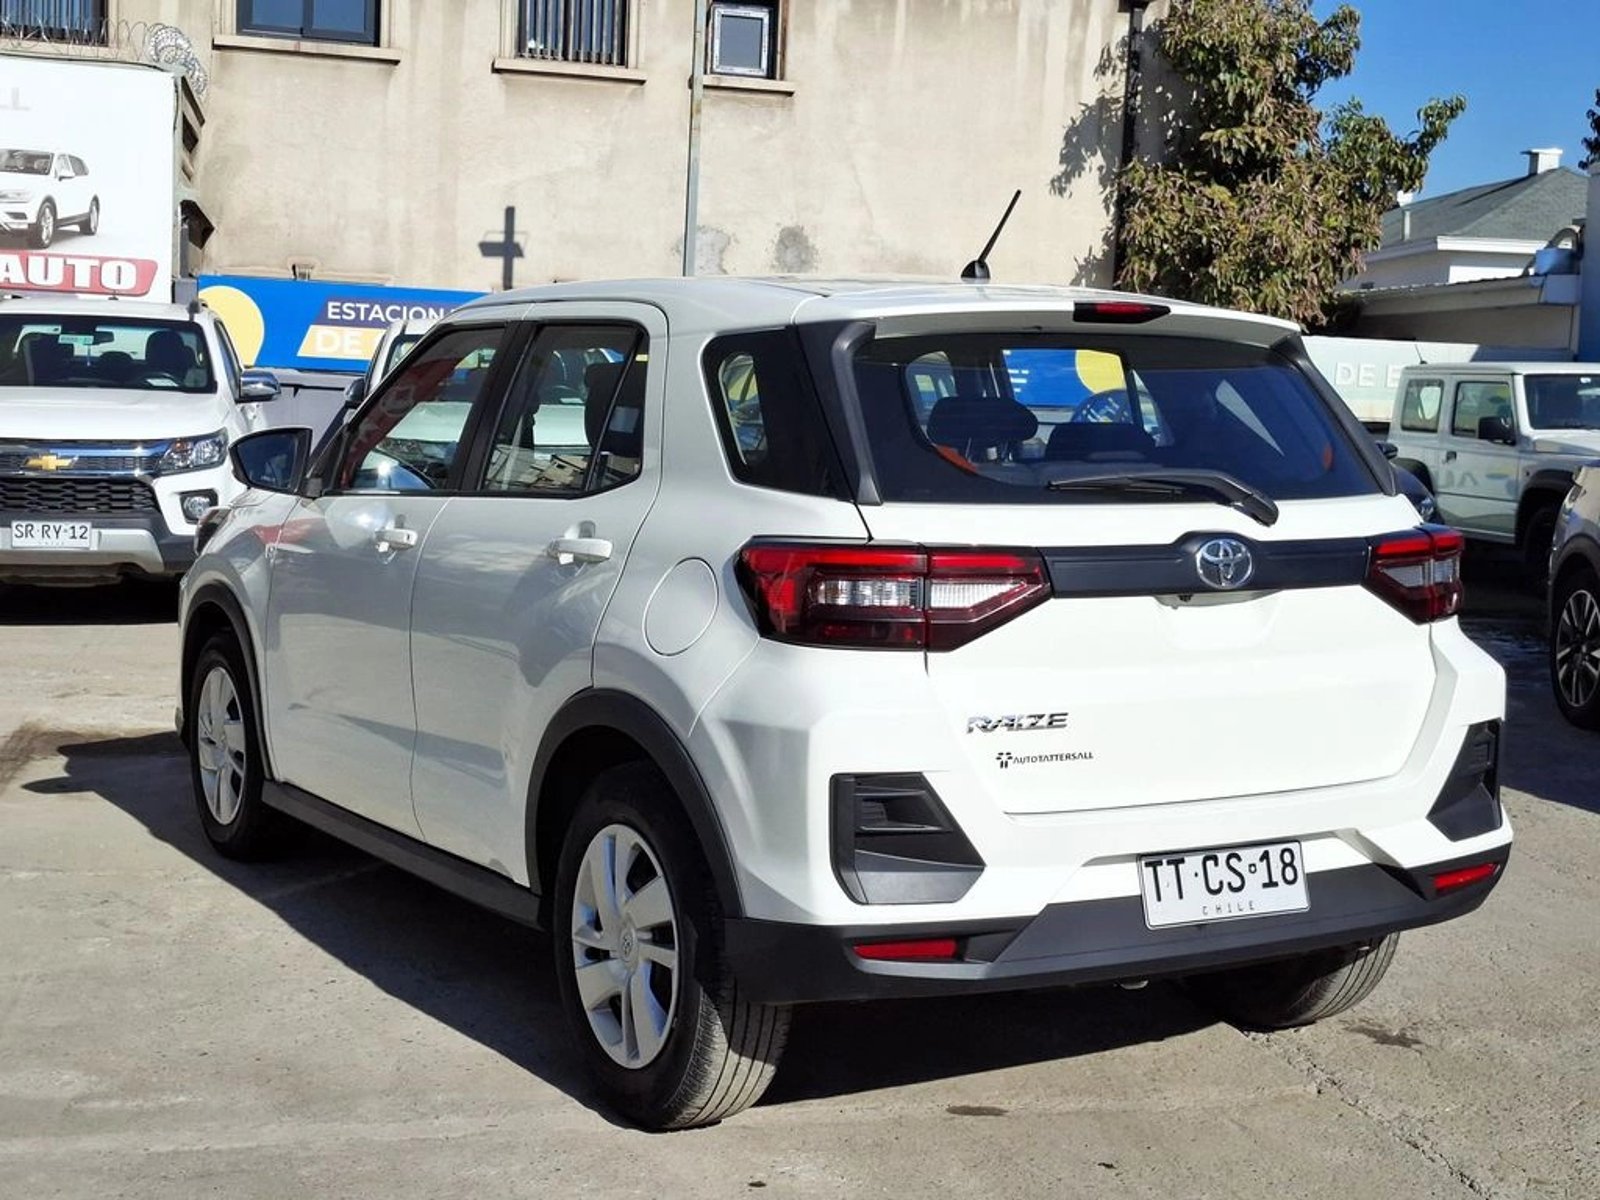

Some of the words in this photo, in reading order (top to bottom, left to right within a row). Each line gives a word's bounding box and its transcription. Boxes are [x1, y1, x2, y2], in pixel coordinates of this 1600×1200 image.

[0, 254, 137, 291] AUTO
[327, 301, 458, 323] ESTACION
[315, 329, 364, 356] DE
[1335, 362, 1377, 387] DE
[966, 712, 1069, 734] RAIZE
[1202, 900, 1255, 916] CHILE
